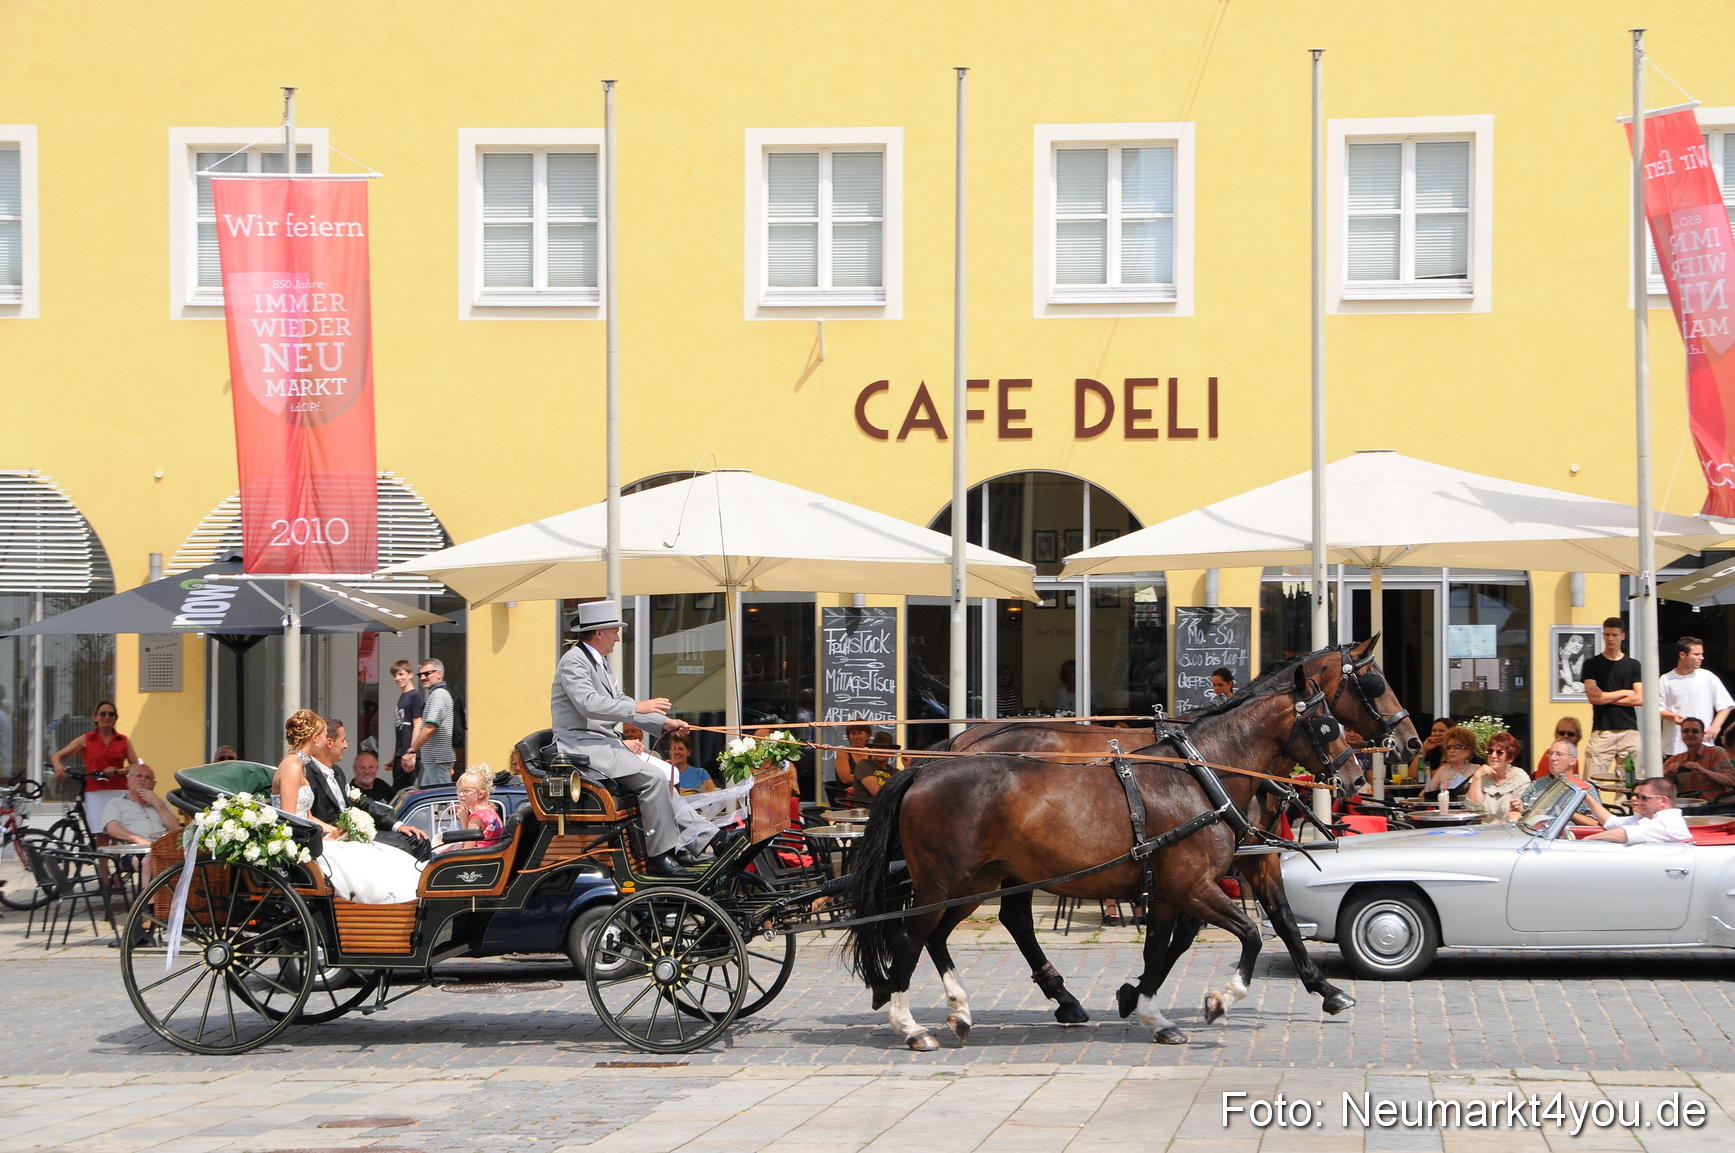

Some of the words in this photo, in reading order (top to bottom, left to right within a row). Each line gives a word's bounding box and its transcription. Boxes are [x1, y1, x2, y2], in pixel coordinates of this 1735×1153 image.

[223, 214, 278, 237] Wir
[285, 212, 364, 237] feiern
[272, 280, 292, 288] 850
[292, 280, 324, 290] Jahre
[253, 293, 346, 314] IMMER
[250, 318, 352, 338] WIEDER
[260, 342, 345, 372] NEU
[265, 378, 348, 397] MARKT
[855, 378, 1032, 440] CAFE
[1075, 377, 1218, 439] DELI
[270, 517, 350, 546] 2010
[1205, 652, 1221, 666] bis
